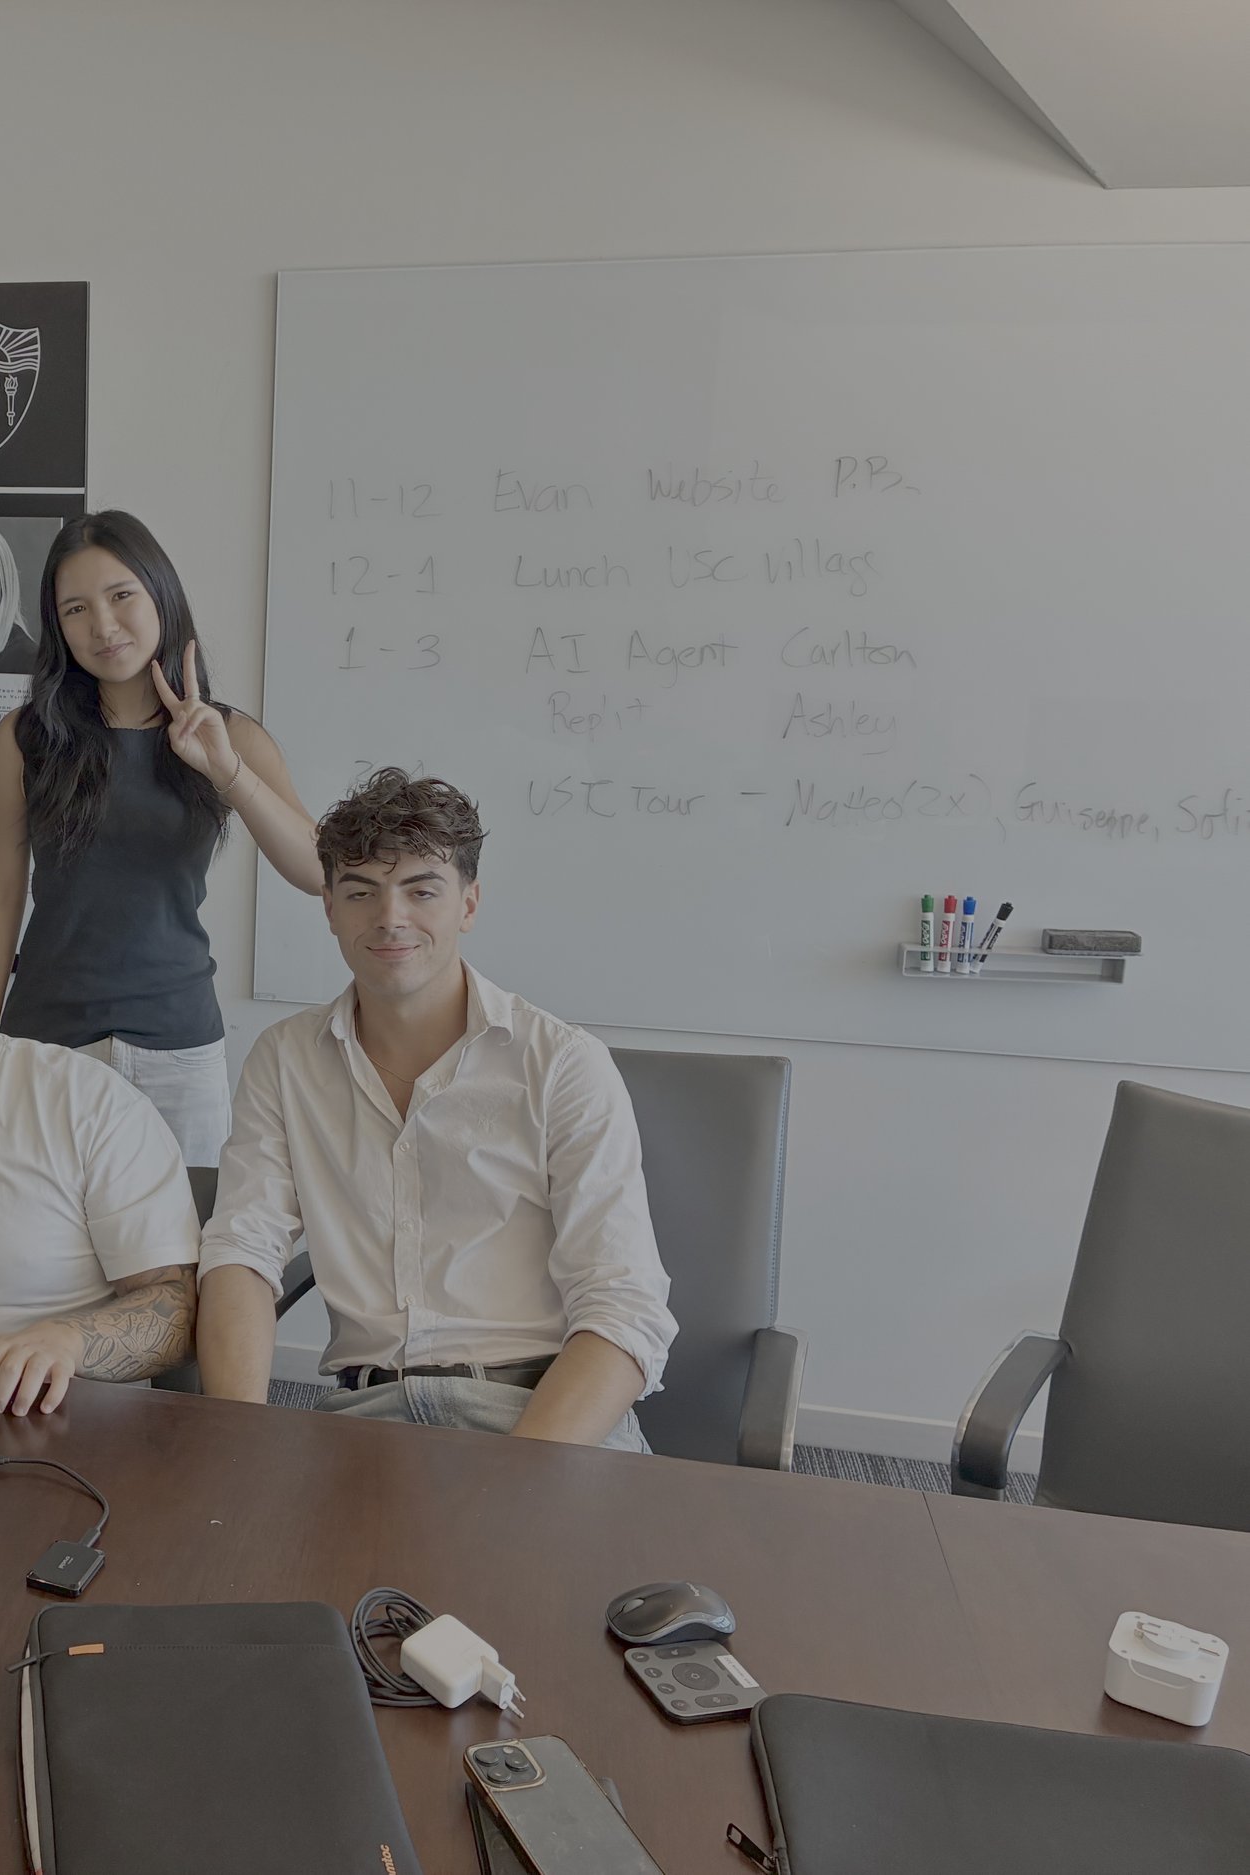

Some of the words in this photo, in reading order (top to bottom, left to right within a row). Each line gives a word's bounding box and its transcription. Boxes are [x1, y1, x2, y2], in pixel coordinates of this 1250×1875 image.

[494, 468, 593, 512] Evan
[647, 460, 786, 507] Website
[515, 552, 632, 588] Lunch
[668, 546, 748, 588] USC
[525, 626, 591, 674] AI
[628, 629, 739, 688] Agent
[780, 626, 918, 670] Carlton
[547, 690, 653, 743] Replit
[782, 692, 896, 756] Ashley
[630, 785, 706, 816] Tour
[1175, 787, 1250, 840] Sofi
[380, 1844, 397, 1875] mtoc
